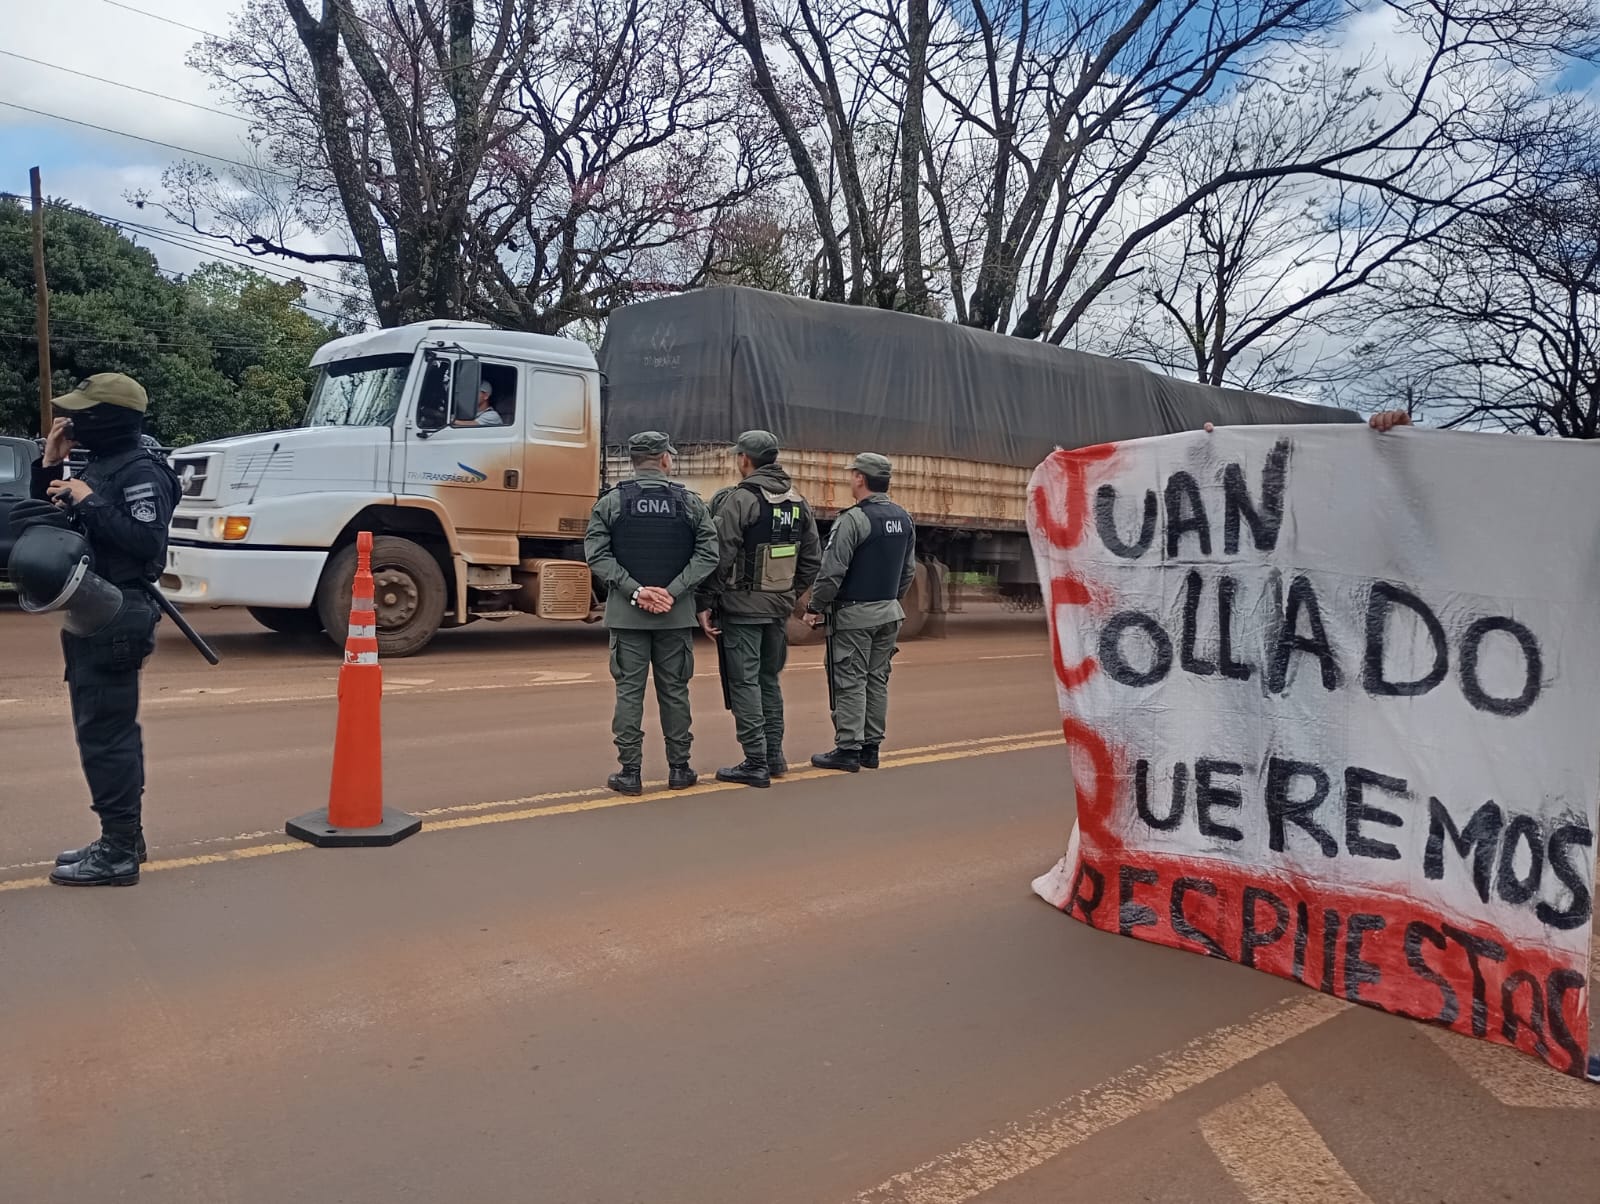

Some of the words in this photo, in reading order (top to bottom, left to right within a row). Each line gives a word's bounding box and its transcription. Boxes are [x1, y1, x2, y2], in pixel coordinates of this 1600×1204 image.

[636, 499, 671, 514] GNA
[885, 520, 903, 534] GNA
[1034, 436, 1291, 559] JUAN
[1051, 568, 1543, 717] COLLADO
[1063, 717, 1593, 930] QUEREMOS
